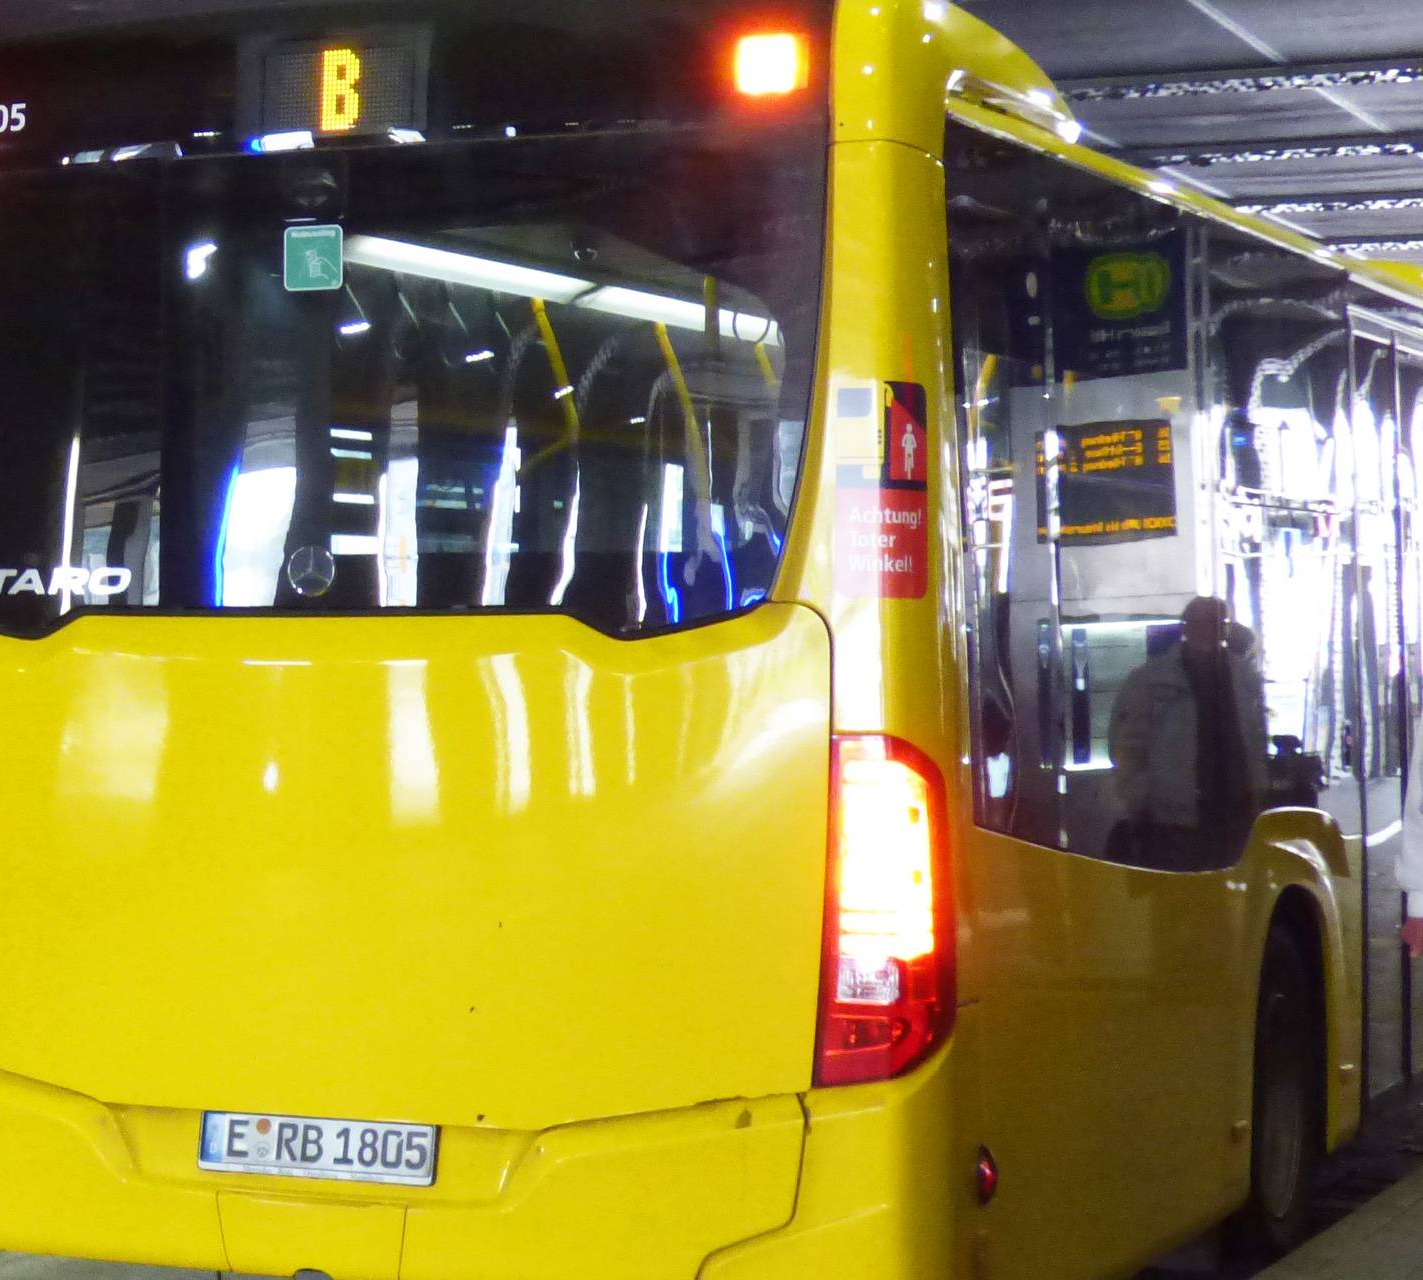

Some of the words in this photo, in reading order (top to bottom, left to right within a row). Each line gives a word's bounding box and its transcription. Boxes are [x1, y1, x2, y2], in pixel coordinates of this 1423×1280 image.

[322, 49, 360, 131] B
[848, 505, 922, 529] Achtung!
[848, 531, 897, 548] Toter
[848, 553, 913, 574] Winkel!
[227, 1119, 250, 1158] E
[276, 1122, 324, 1163] RB
[333, 1127, 428, 1170] 1805
